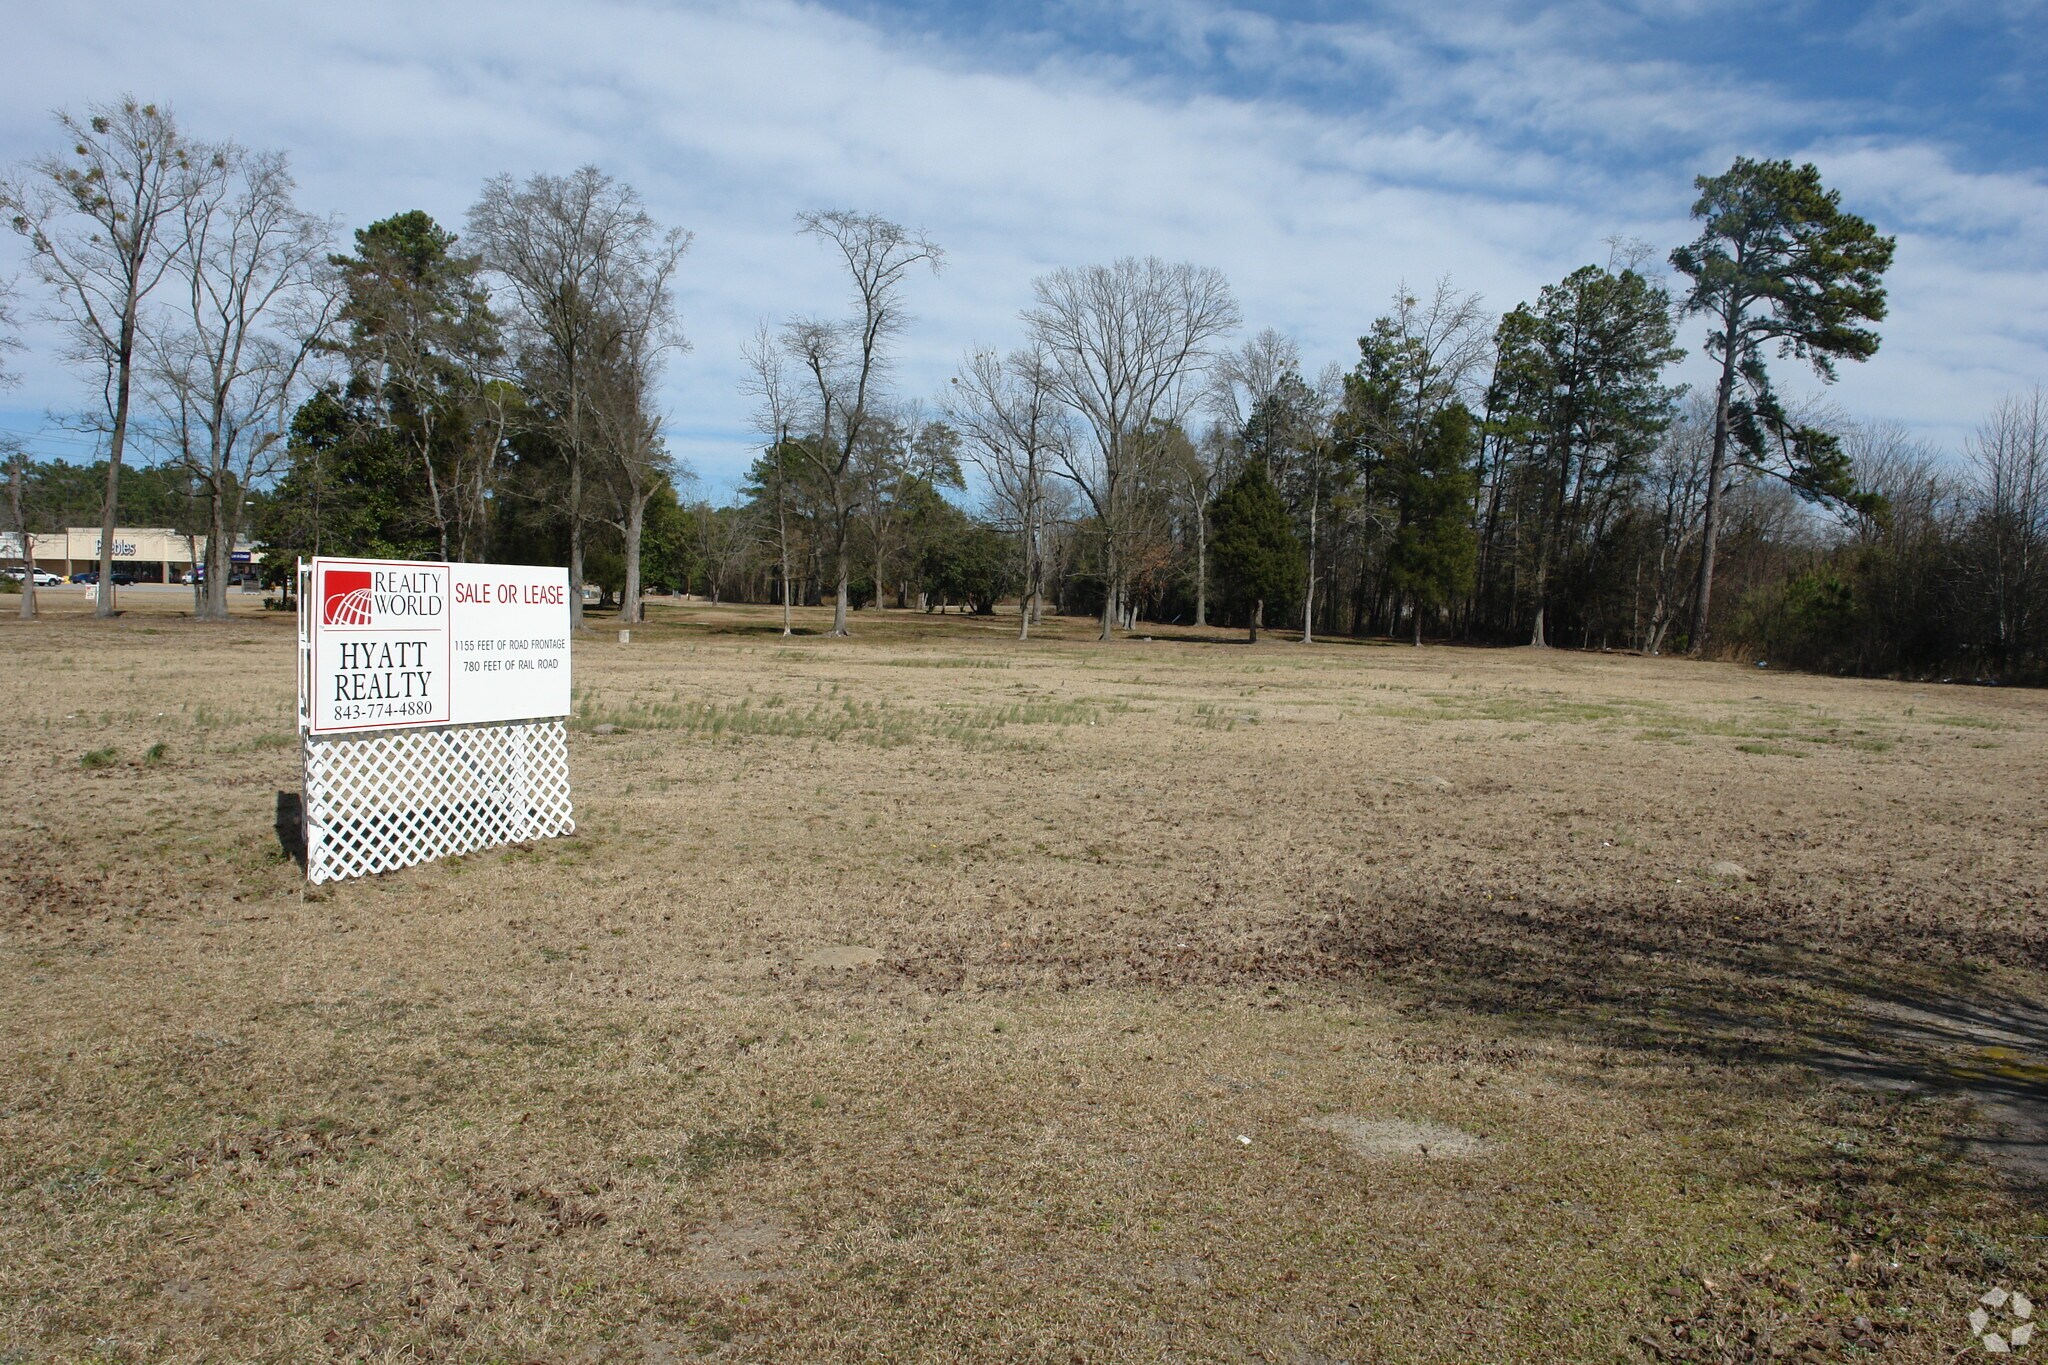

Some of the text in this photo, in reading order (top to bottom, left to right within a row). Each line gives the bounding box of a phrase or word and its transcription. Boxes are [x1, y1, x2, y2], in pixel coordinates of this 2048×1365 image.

[95, 539, 137, 556] Pebles
[375, 571, 441, 593] REALTY
[455, 582, 564, 605] SALE OR LEASE
[374, 594, 442, 616] WORLD
[339, 641, 428, 670] HYATT
[455, 638, 566, 651] 1155 FEET OF ROAD FRONTAGE
[463, 658, 559, 672] 780 FEET OF RAIL ROAD
[334, 670, 433, 702] REALTY
[334, 700, 433, 721] 843-774-4880
